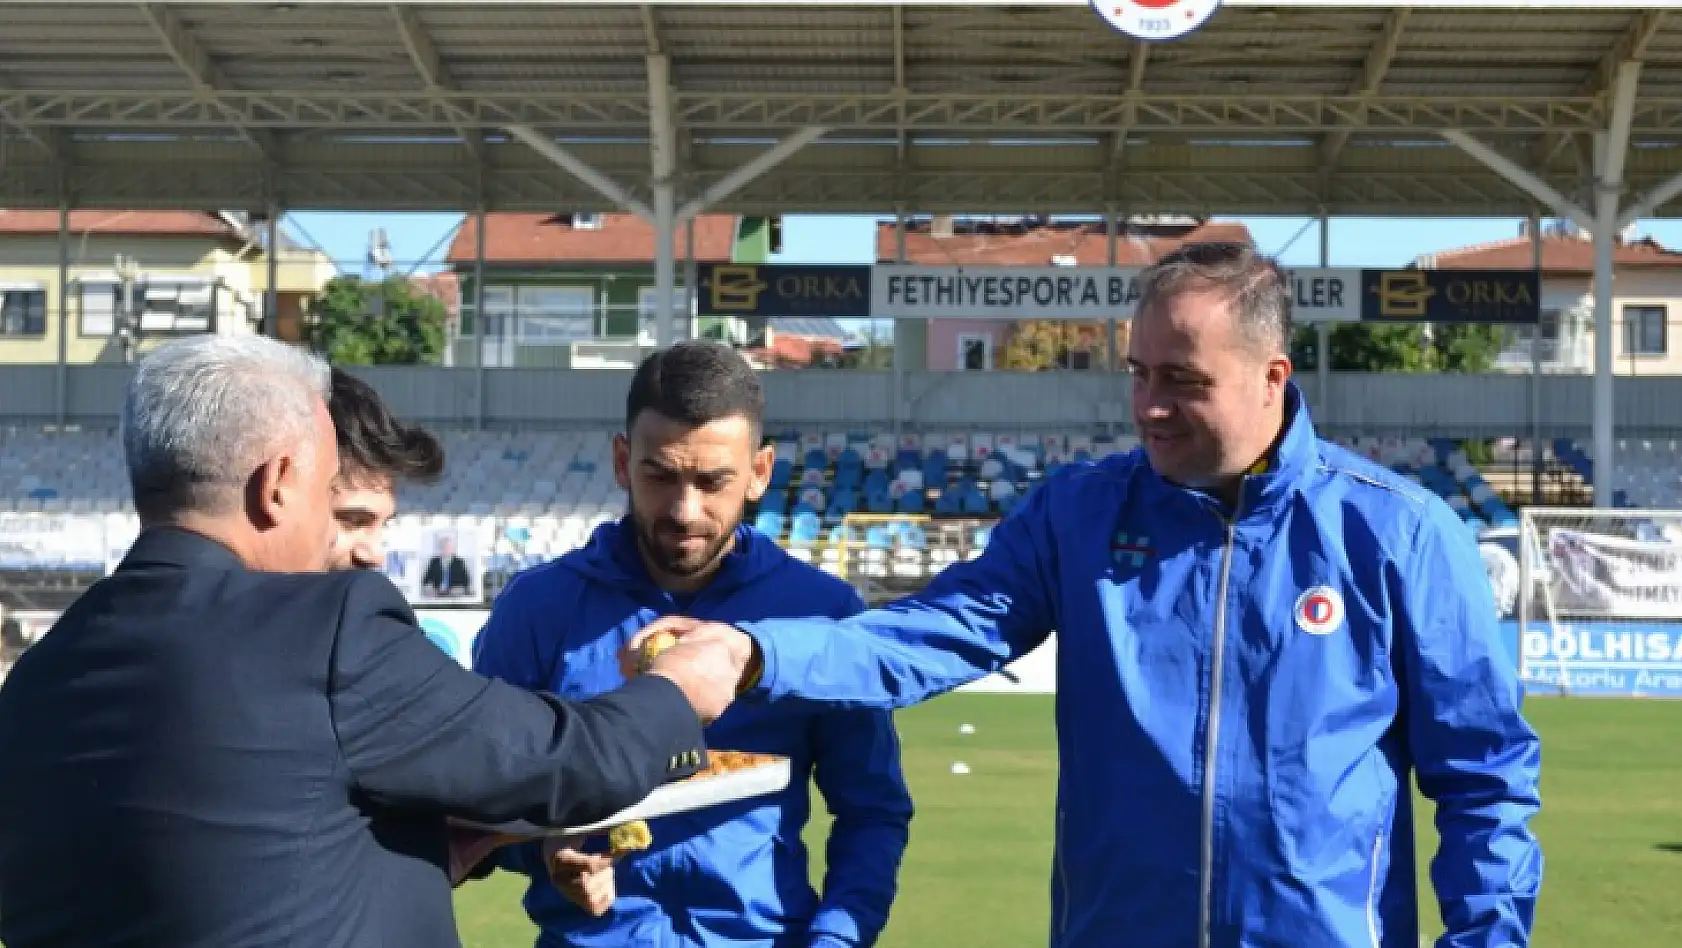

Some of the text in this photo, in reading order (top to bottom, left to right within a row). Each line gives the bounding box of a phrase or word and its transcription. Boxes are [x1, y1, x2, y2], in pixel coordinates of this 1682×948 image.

[776, 275, 863, 299] ORKA
[887, 268, 1099, 307] FETHİYESPOR'A
[1445, 280, 1533, 306] ORKA
